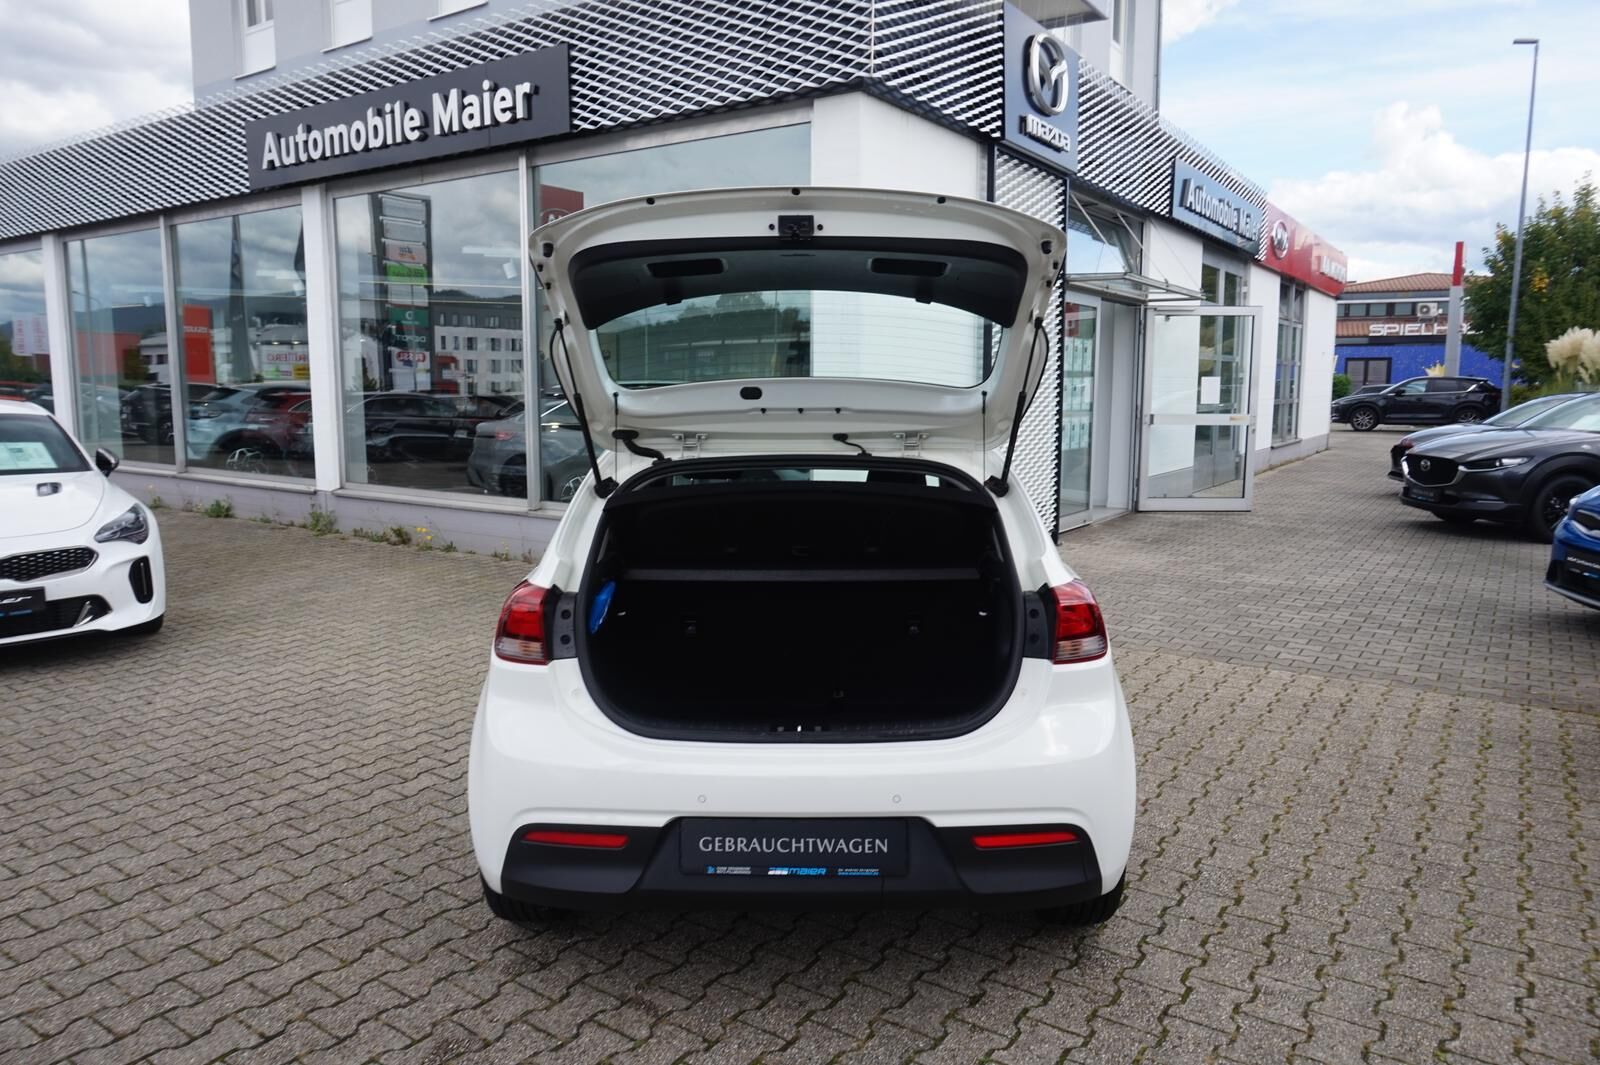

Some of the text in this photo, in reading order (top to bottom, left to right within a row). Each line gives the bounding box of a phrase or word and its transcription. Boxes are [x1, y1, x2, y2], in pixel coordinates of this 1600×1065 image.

[261, 80, 536, 171] Automobile Maier
[1185, 177, 1239, 232] Automobile
[698, 836, 889, 854] GEBRAUCHTWAGEN
